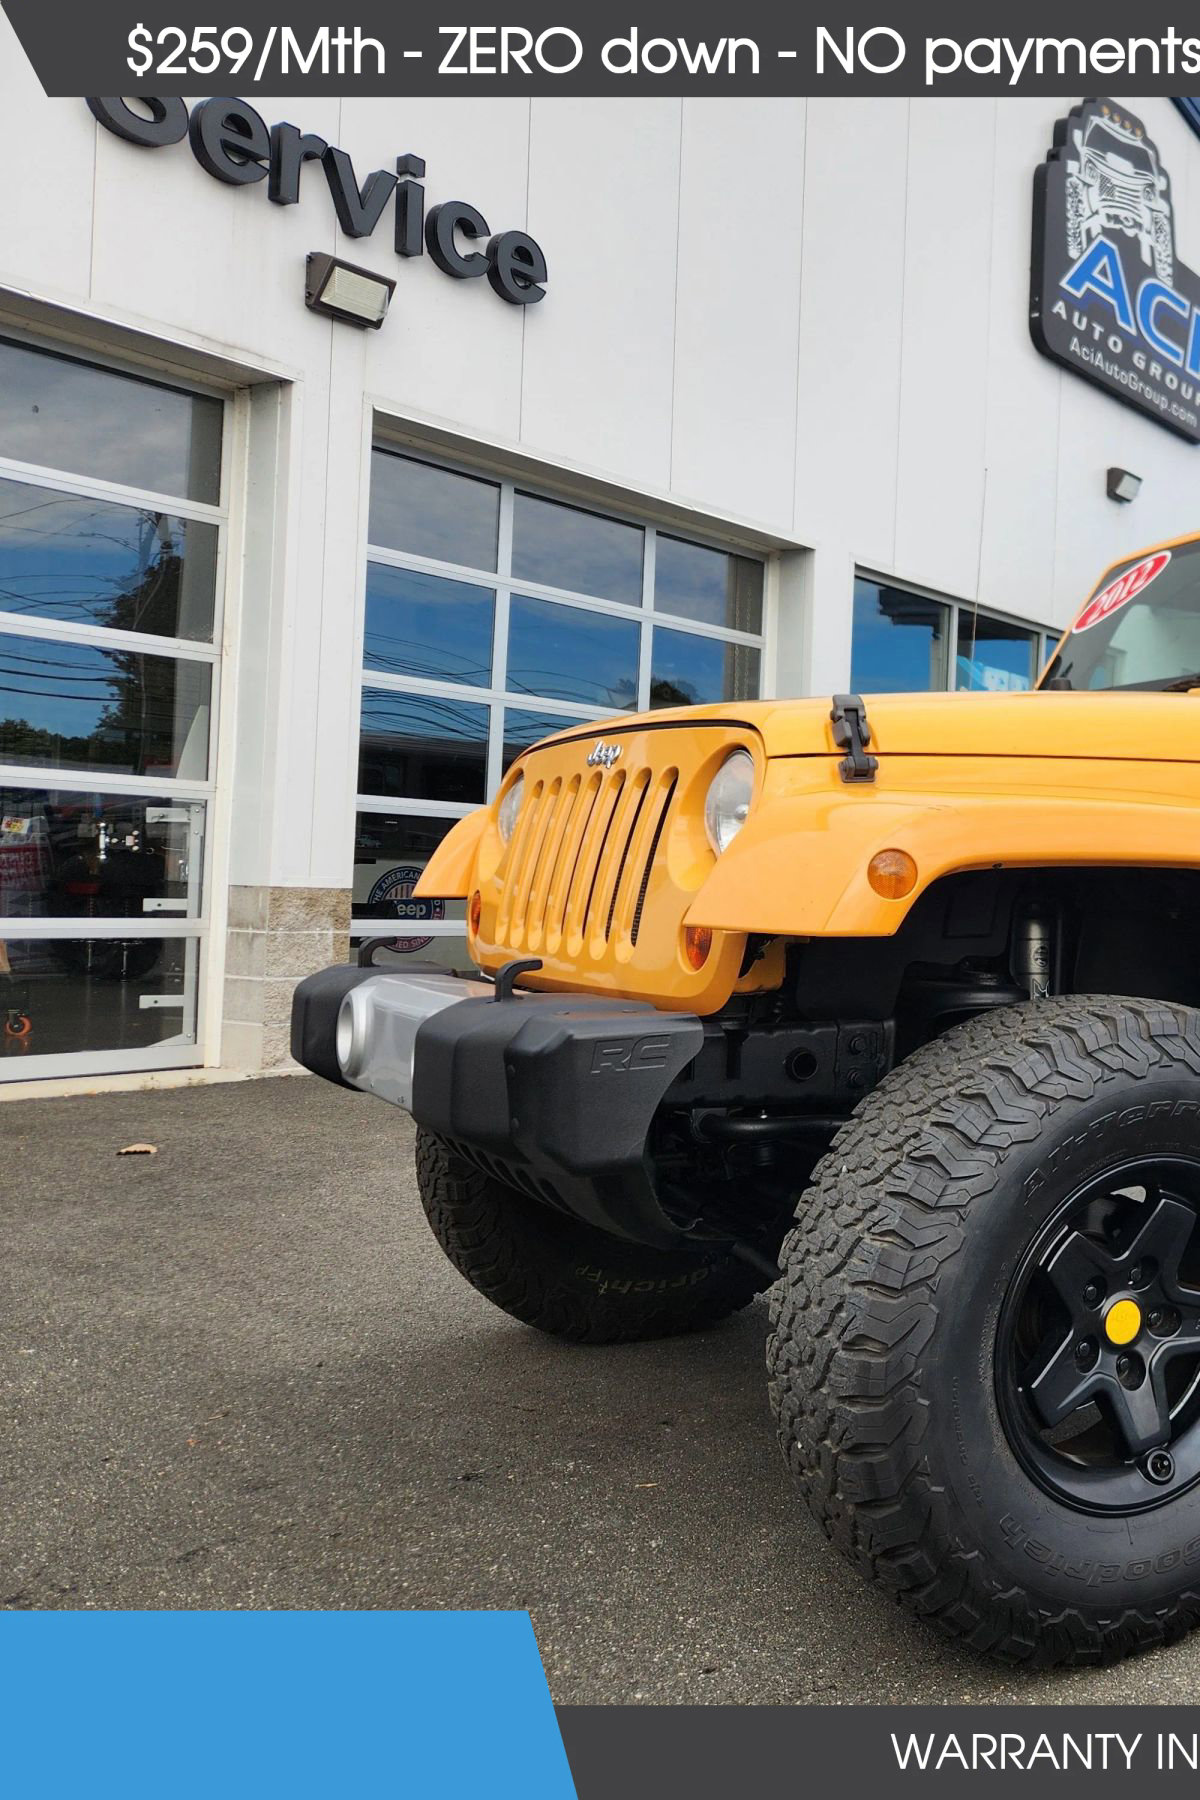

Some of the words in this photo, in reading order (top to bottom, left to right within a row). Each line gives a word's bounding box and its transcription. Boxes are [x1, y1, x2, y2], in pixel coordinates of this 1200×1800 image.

[1051, 300, 1123, 354] AUTO
[1069, 337, 1198, 429] AciAutoGroup.com
[1087, 560, 1155, 625] 2012
[587, 741, 621, 769] Jeep
[395, 902, 427, 919] eep
